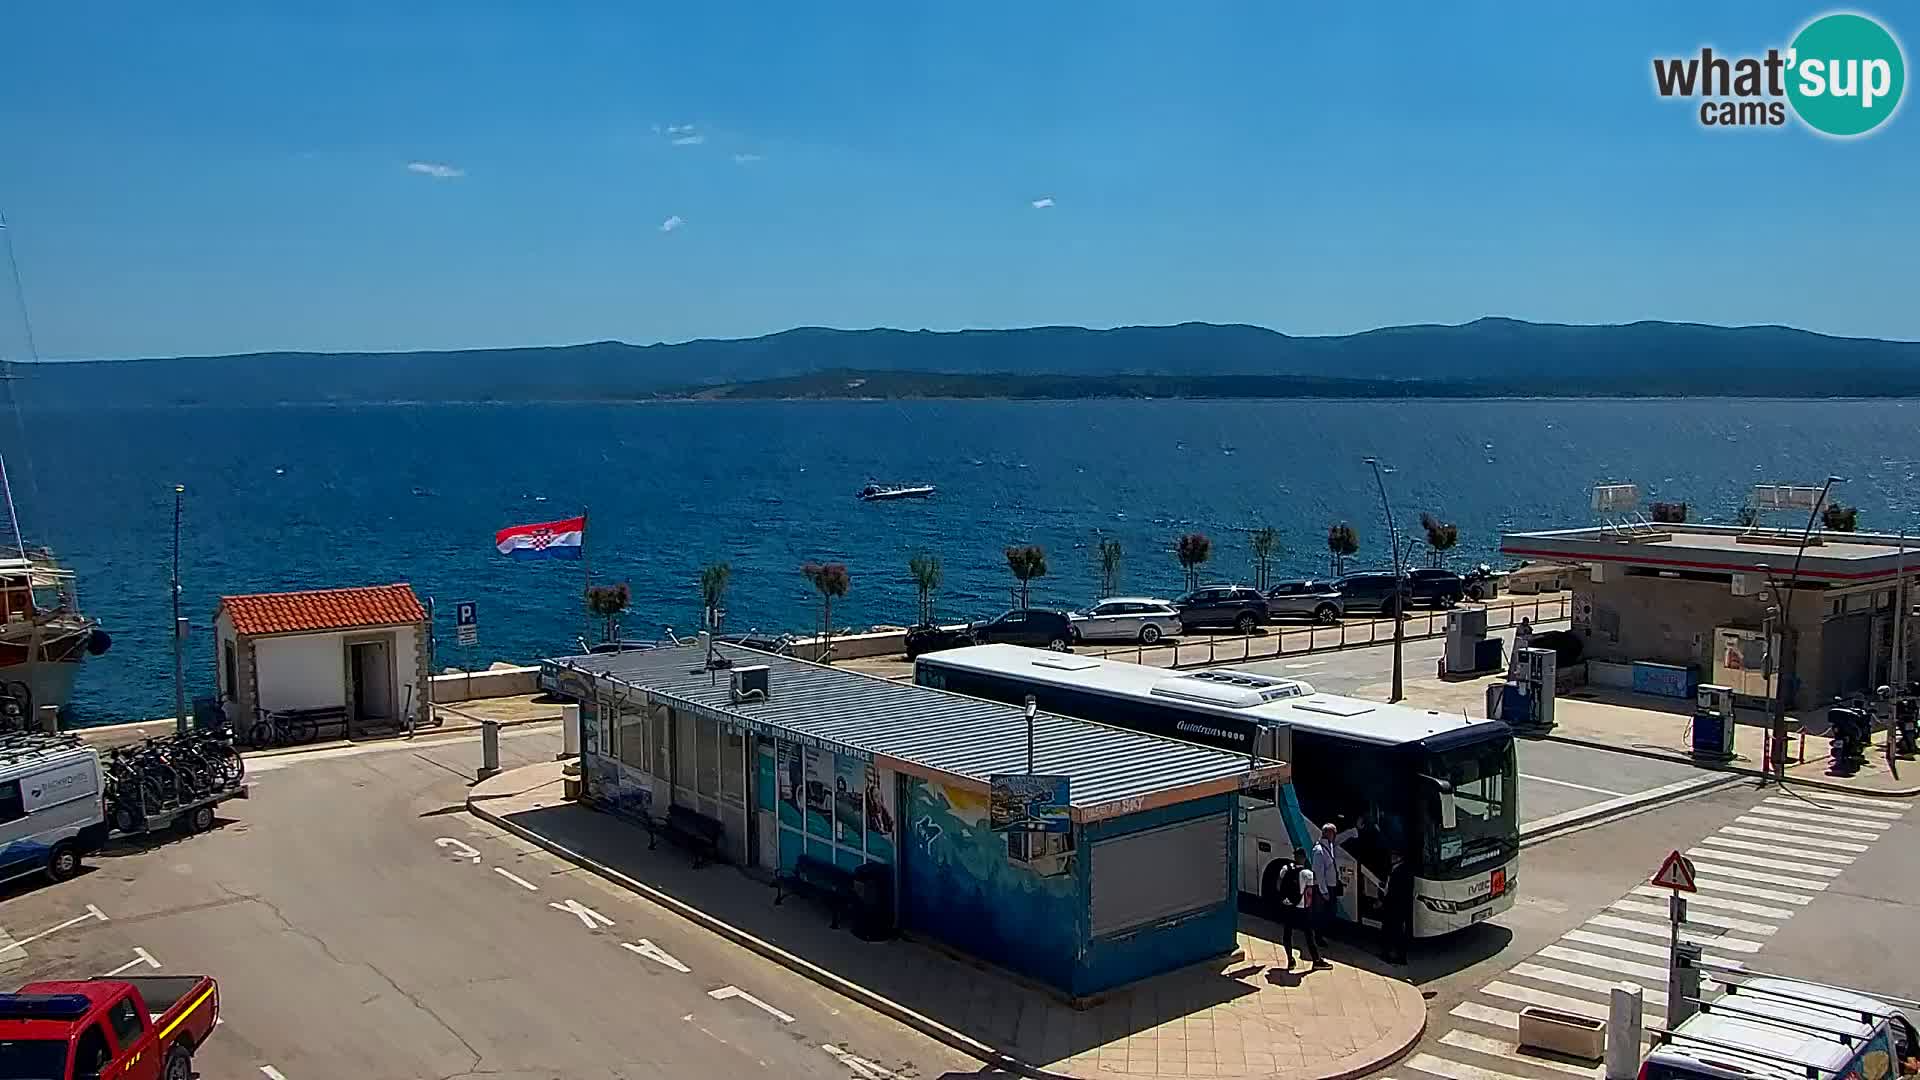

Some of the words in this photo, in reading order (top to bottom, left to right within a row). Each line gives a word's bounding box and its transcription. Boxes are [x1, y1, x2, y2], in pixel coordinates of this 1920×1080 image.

[461, 605, 471, 622] P
[772, 726, 786, 739] BUS
[786, 730, 817, 748] STATION
[819, 739, 843, 753] TICKET
[844, 747, 870, 761] OFFICE
[1469, 880, 1491, 896] IVEC
